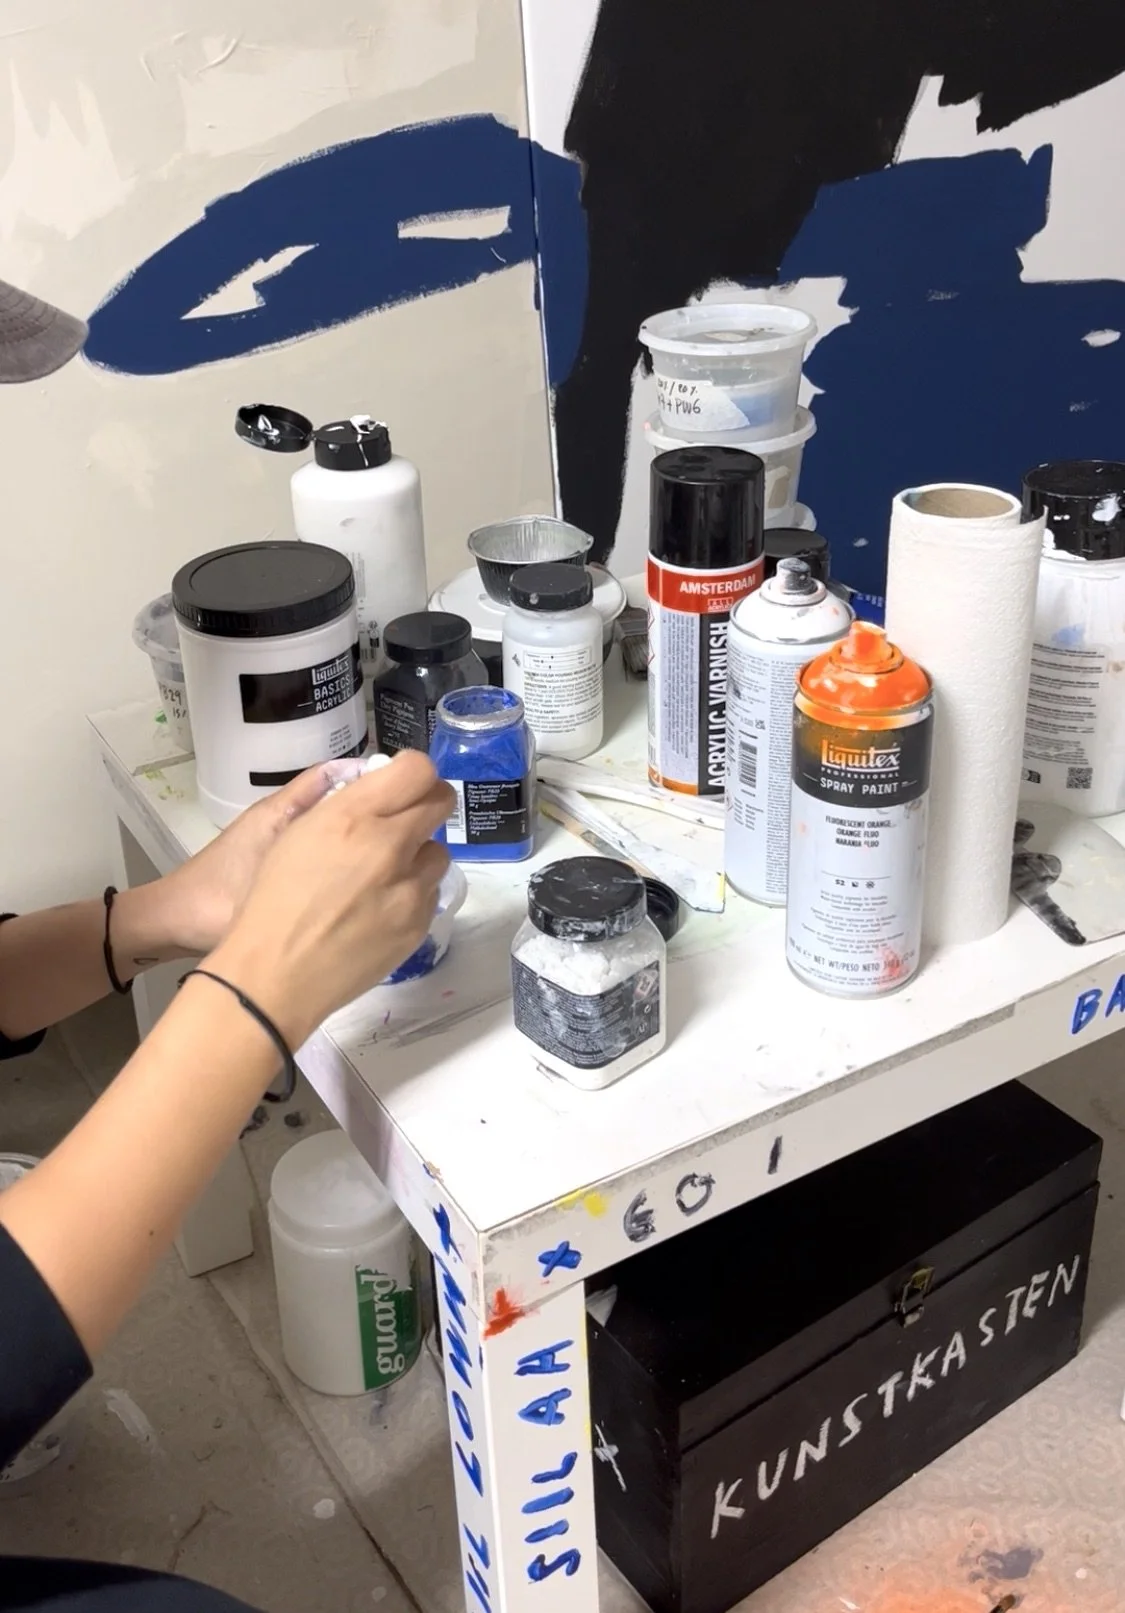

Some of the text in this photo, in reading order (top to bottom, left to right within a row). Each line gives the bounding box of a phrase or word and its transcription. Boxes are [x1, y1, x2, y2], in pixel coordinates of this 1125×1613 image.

[679, 574, 756, 595] AMSTERDAM
[311, 655, 349, 686] Liquitex
[314, 674, 351, 701] BASICS
[315, 687, 351, 713] ACRYLIC
[707, 621, 729, 788] ACRYLIC VARNISH
[821, 739, 901, 772] Liquitex
[820, 766, 899, 780] PROFESSIONAL
[820, 777, 899, 795] SPRAY PAINT
[826, 815, 891, 828] FLUORESCENT ORANGE
[836, 828, 880, 838] ORANGE FLUO
[710, 1254, 1081, 1539] KUNSTKASTEN
